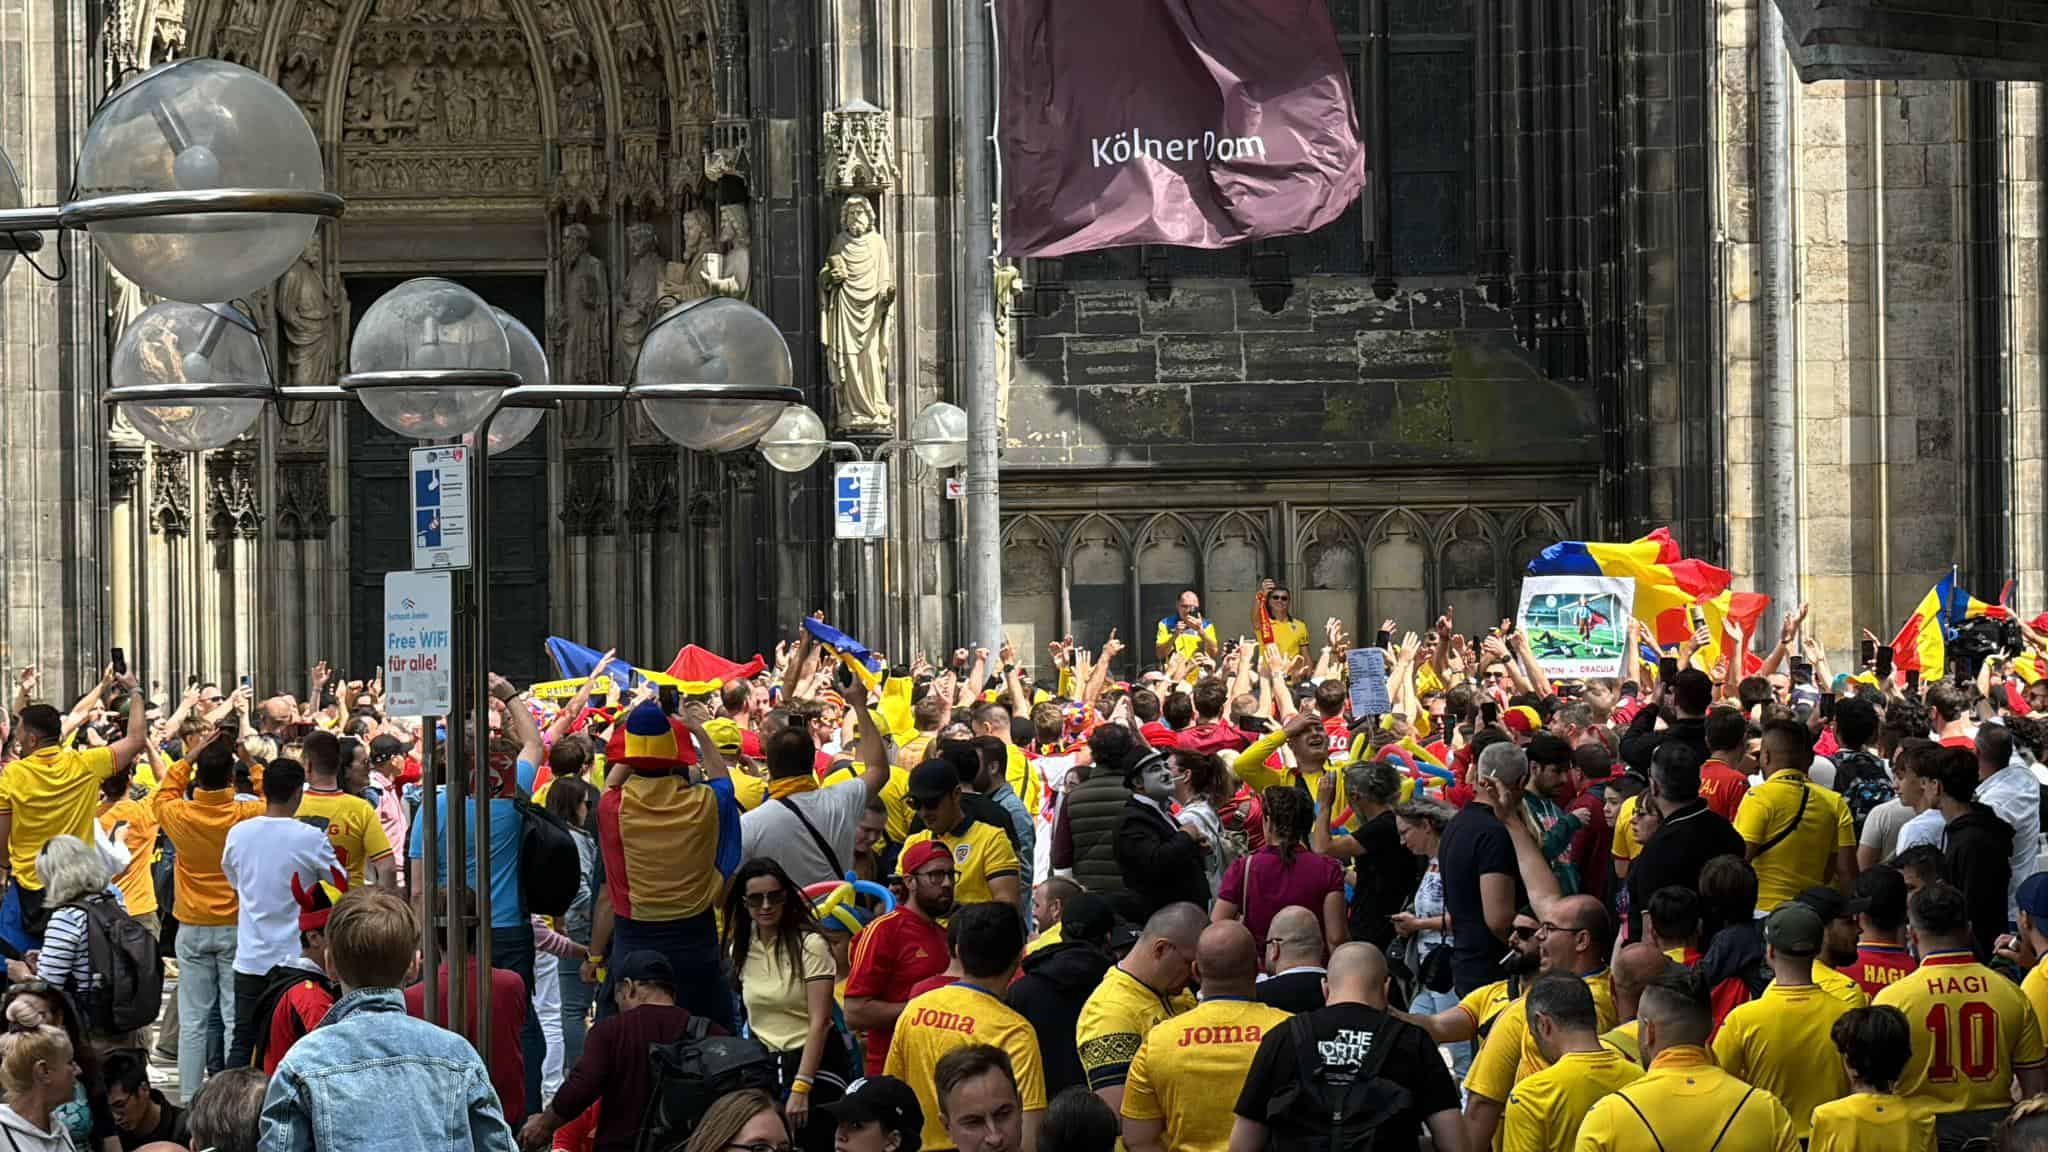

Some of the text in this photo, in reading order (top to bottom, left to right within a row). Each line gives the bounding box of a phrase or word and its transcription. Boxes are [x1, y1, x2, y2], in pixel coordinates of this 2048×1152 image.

[1091, 127, 1266, 168] Kölner Dom
[388, 632, 417, 650] Free
[388, 653, 438, 672] für alle!
[1580, 664, 1616, 673] DRACULA
[328, 821, 350, 836] GI
[1927, 975, 1989, 996] HAGI
[1337, 1029, 1374, 1046] THE
[1925, 1001, 2001, 1084] 10
